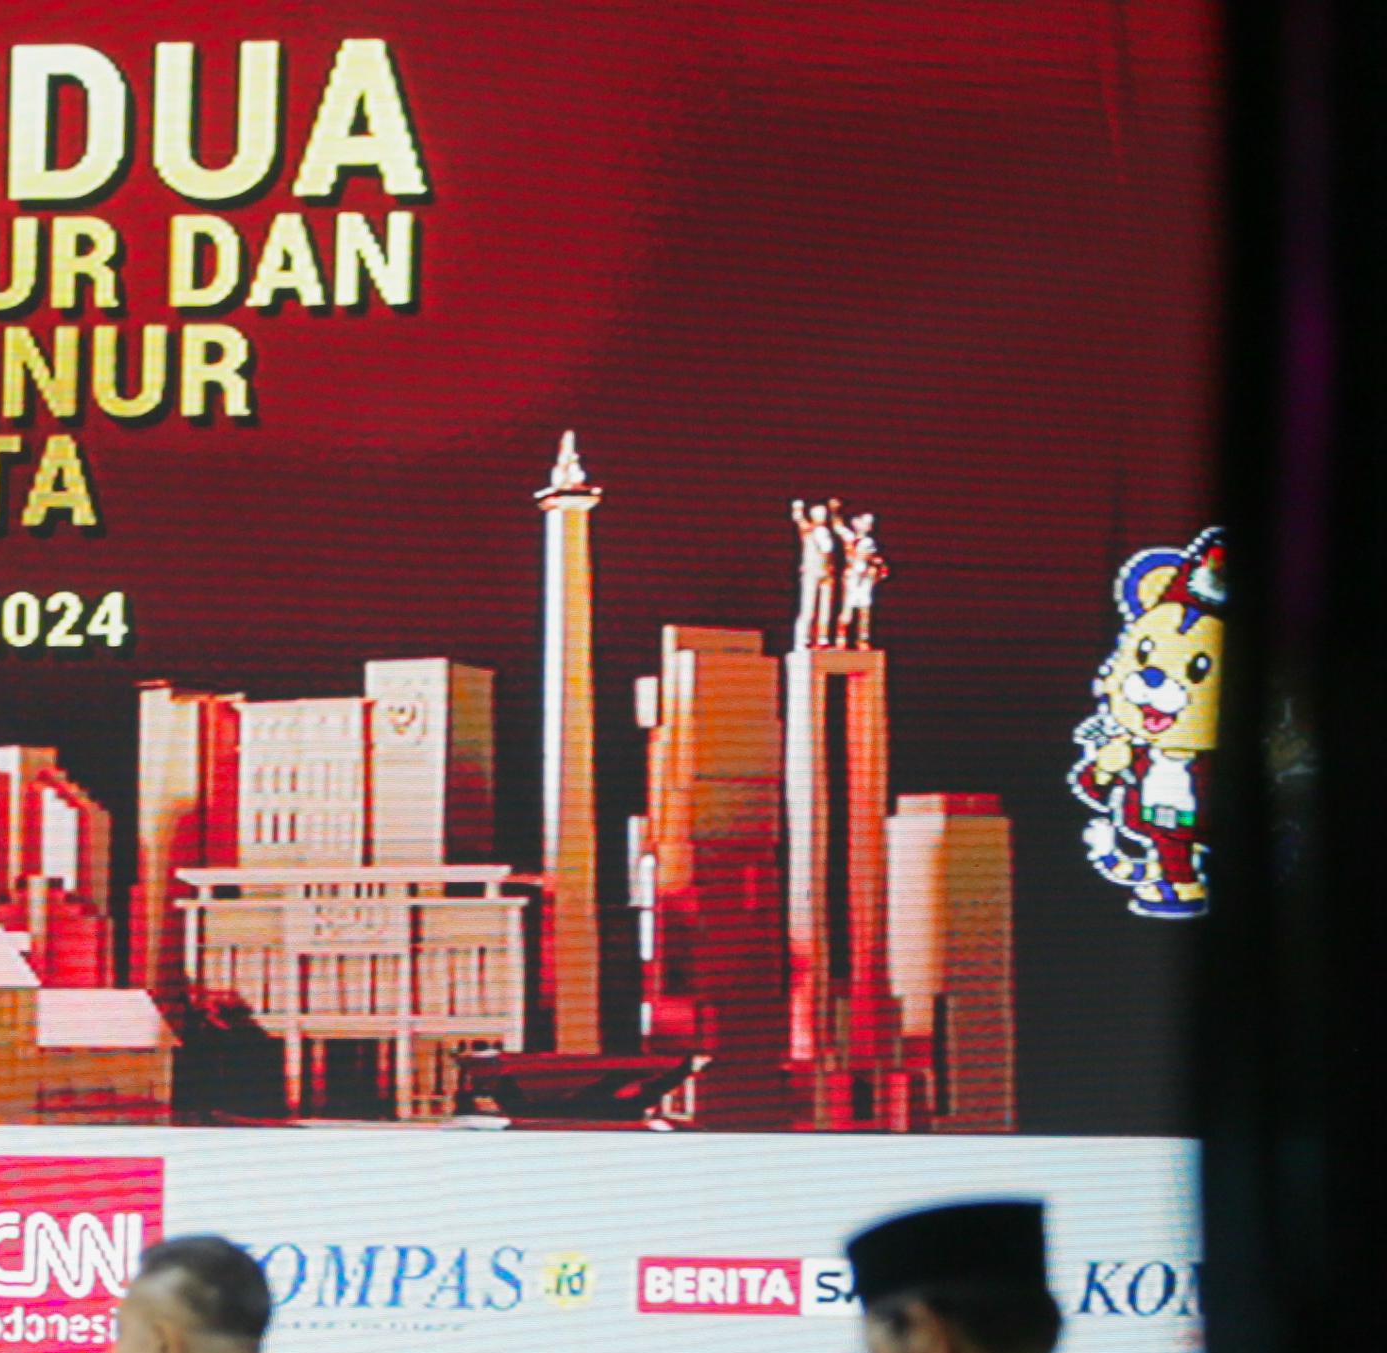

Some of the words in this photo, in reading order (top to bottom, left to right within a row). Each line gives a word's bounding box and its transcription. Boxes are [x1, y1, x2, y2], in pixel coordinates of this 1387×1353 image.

[168, 210, 417, 307] DAN
[239, 1242, 527, 1313] OMPAS
[643, 1266, 797, 1307] BERITA
